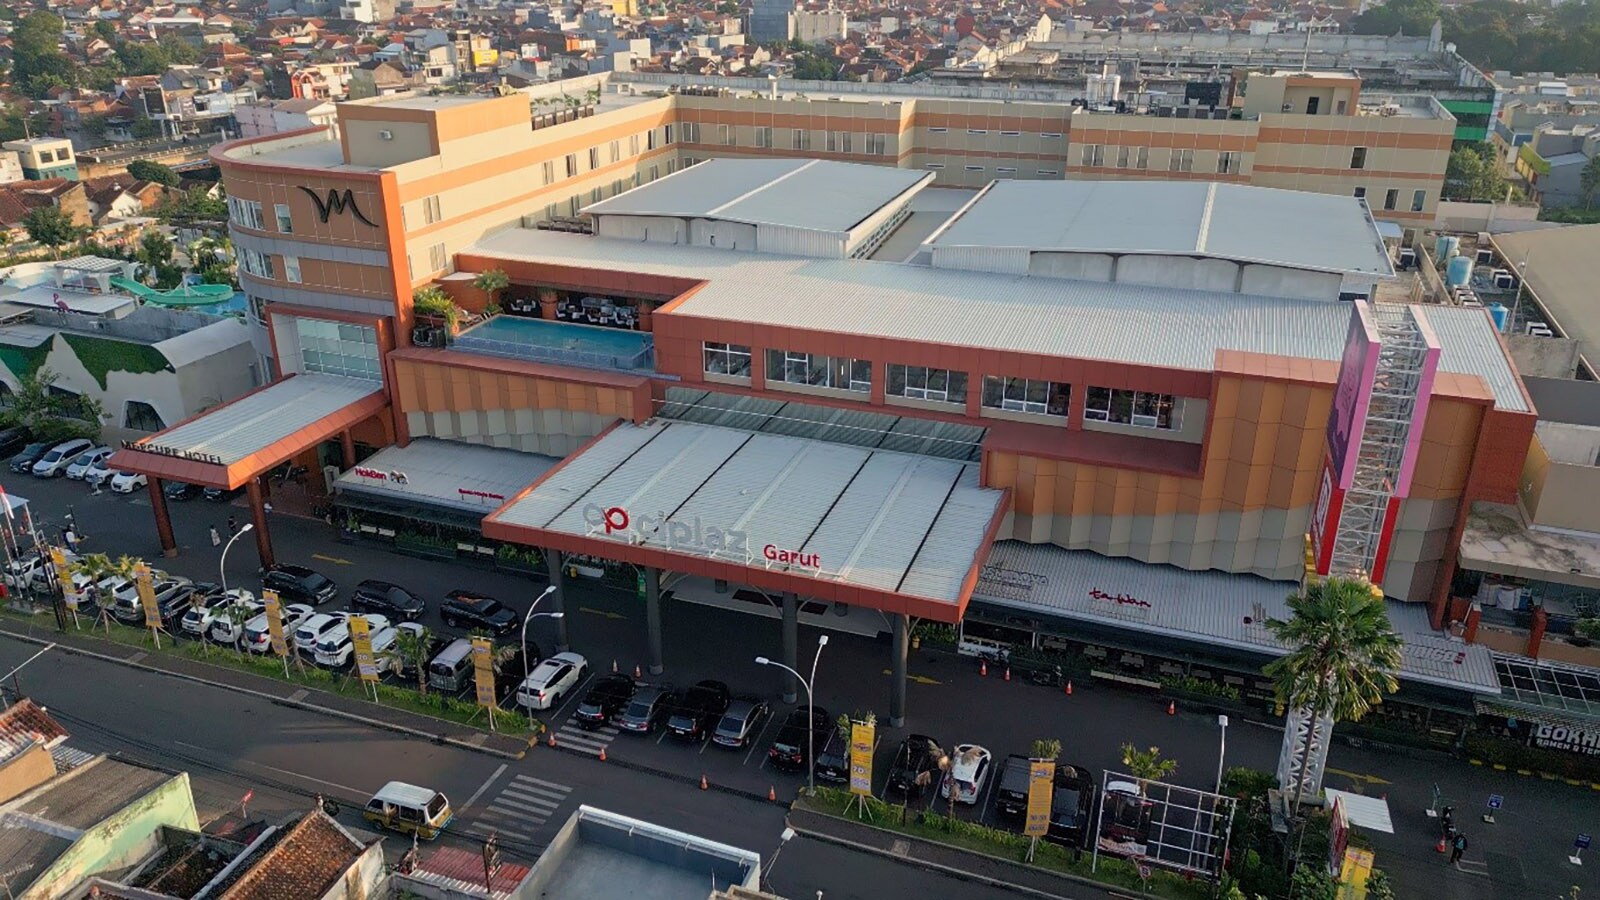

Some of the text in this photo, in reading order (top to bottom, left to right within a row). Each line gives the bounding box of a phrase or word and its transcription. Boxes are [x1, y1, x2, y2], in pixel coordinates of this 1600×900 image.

[121, 440, 222, 465] MERCURE HOTEL
[635, 510, 747, 550] ciplaz
[763, 544, 820, 568] Garut
[1536, 724, 1600, 749] GOKA
[1536, 738, 1570, 749] RAMEN
